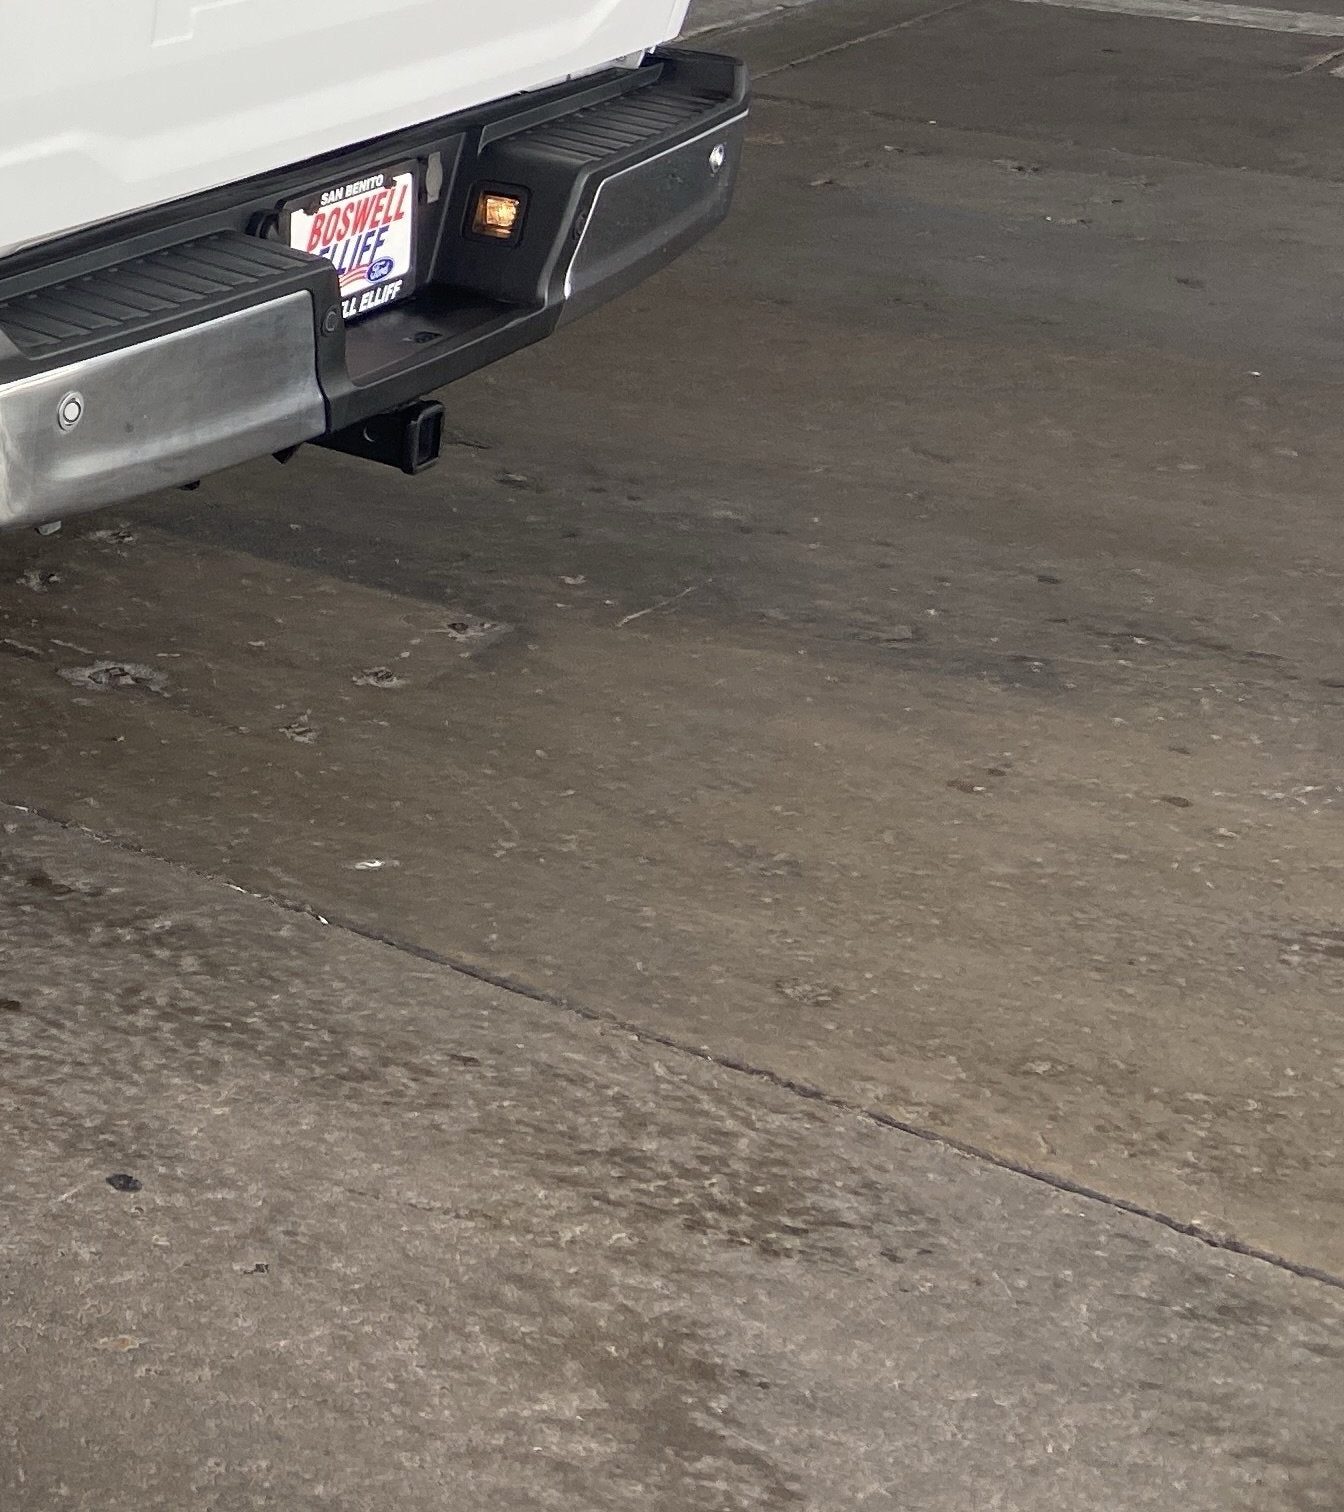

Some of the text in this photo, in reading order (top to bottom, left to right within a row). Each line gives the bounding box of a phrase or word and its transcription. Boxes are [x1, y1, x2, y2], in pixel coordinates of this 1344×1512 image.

[320, 174, 384, 206] SAN BENITO
[306, 184, 408, 252] BOSWELL
[359, 279, 403, 312] ELLIFF
